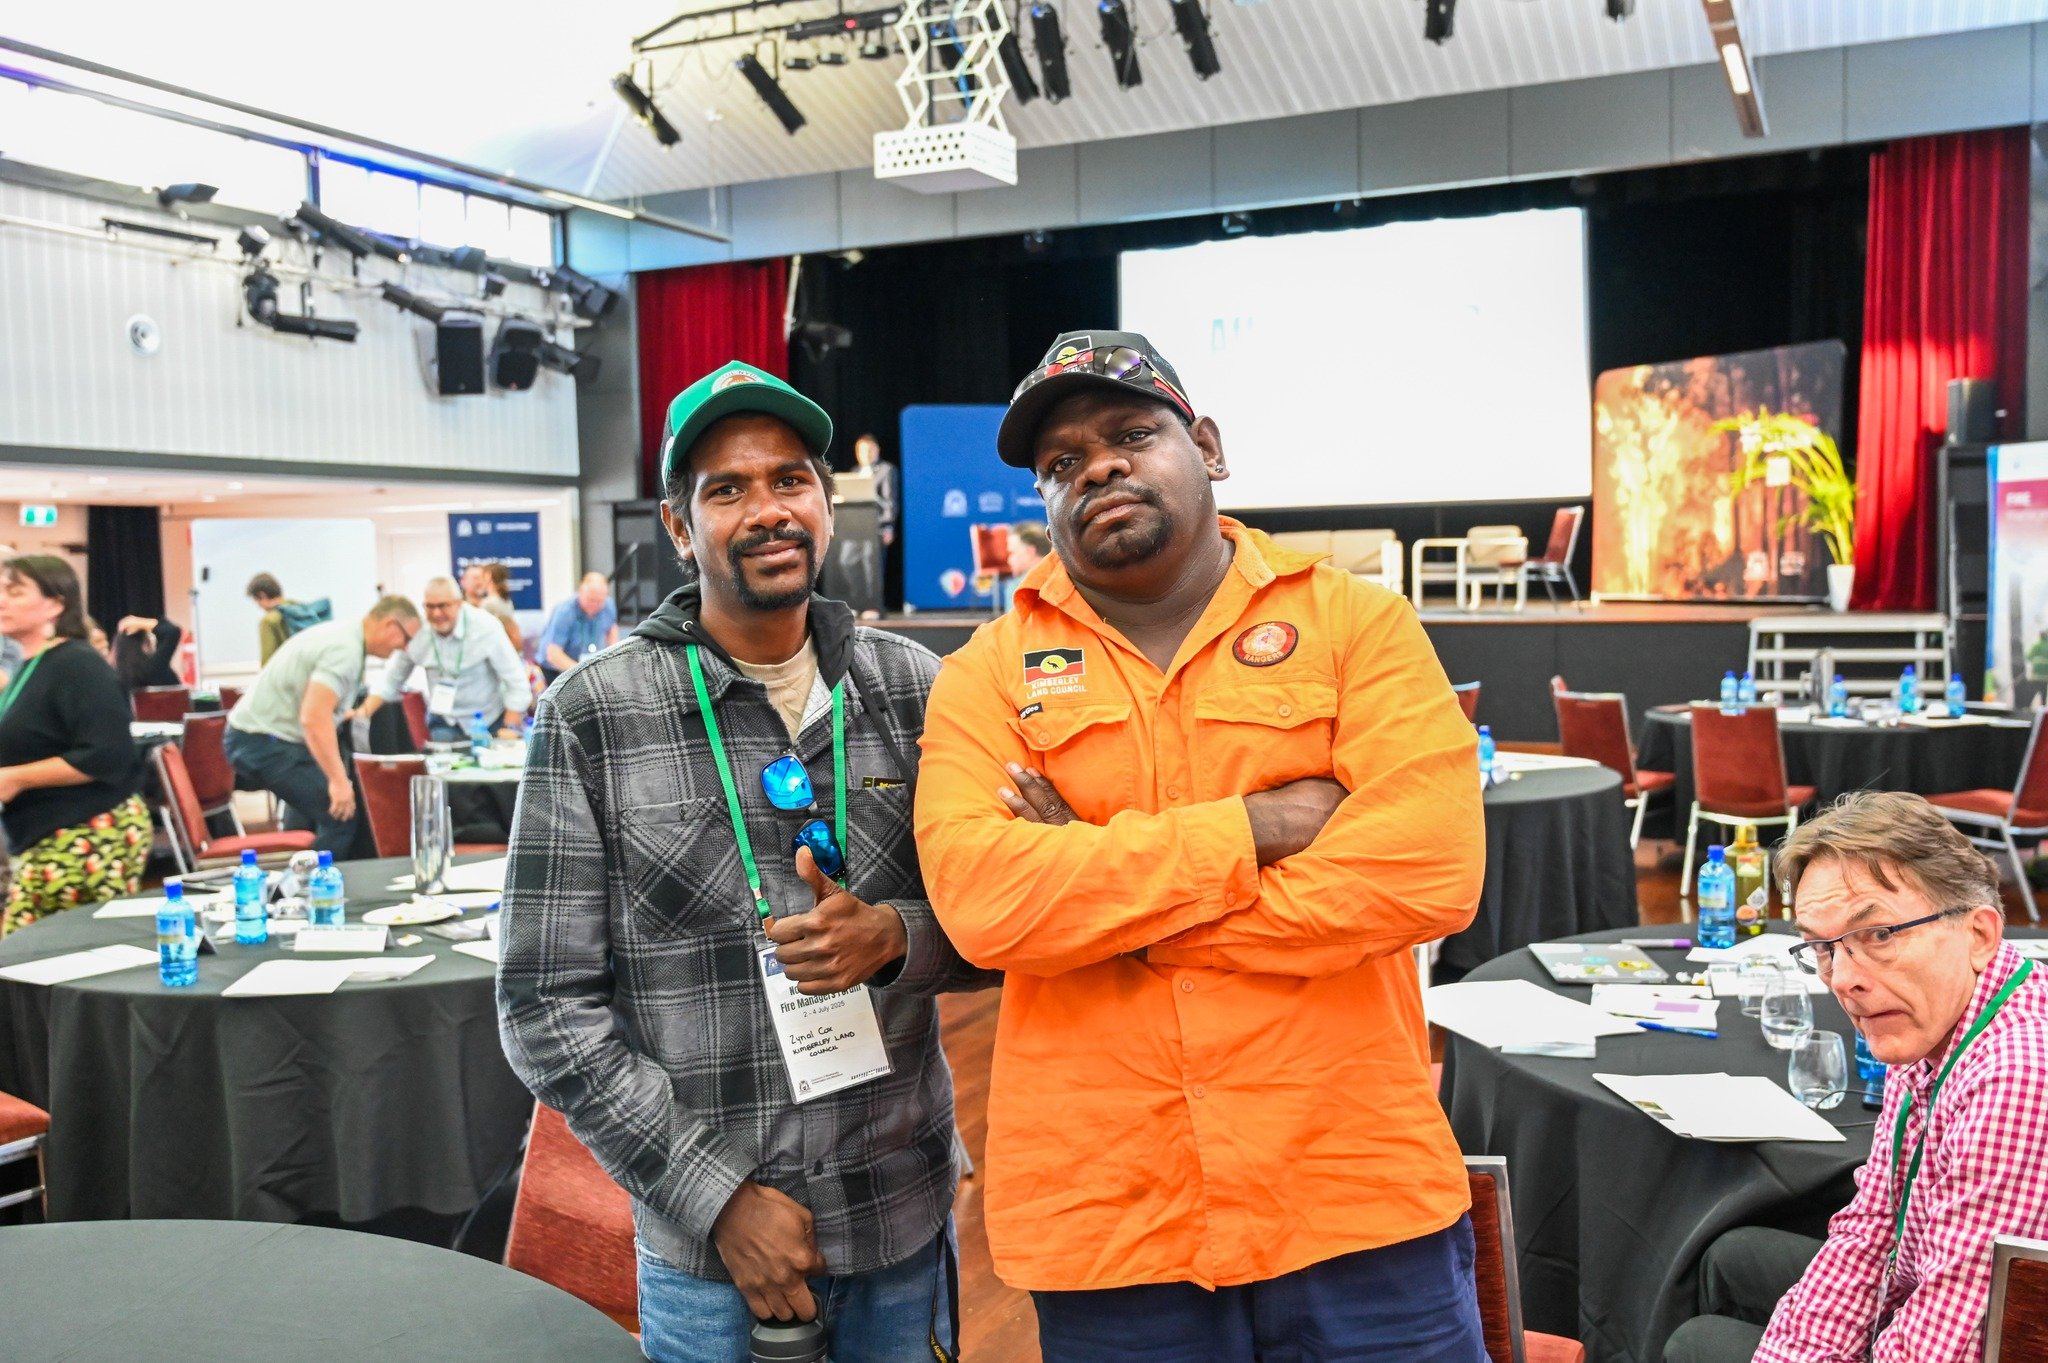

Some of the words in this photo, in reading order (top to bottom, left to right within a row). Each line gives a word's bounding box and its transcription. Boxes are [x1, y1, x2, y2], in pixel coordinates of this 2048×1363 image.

[1243, 651, 1285, 663] RANGERS
[1031, 675, 1079, 690] KIMBERLEY
[1026, 687, 1048, 700] LAND
[1050, 683, 1087, 695] COUNCIL
[780, 1001, 796, 1014] Fire
[797, 991, 837, 1009] Managers
[818, 1005, 830, 1014] July
[817, 1026, 833, 1035] Cox
[792, 1037, 831, 1055] KIMBERLEY
[834, 1031, 856, 1041] LAND
[809, 1045, 839, 1058] COUNCIL
